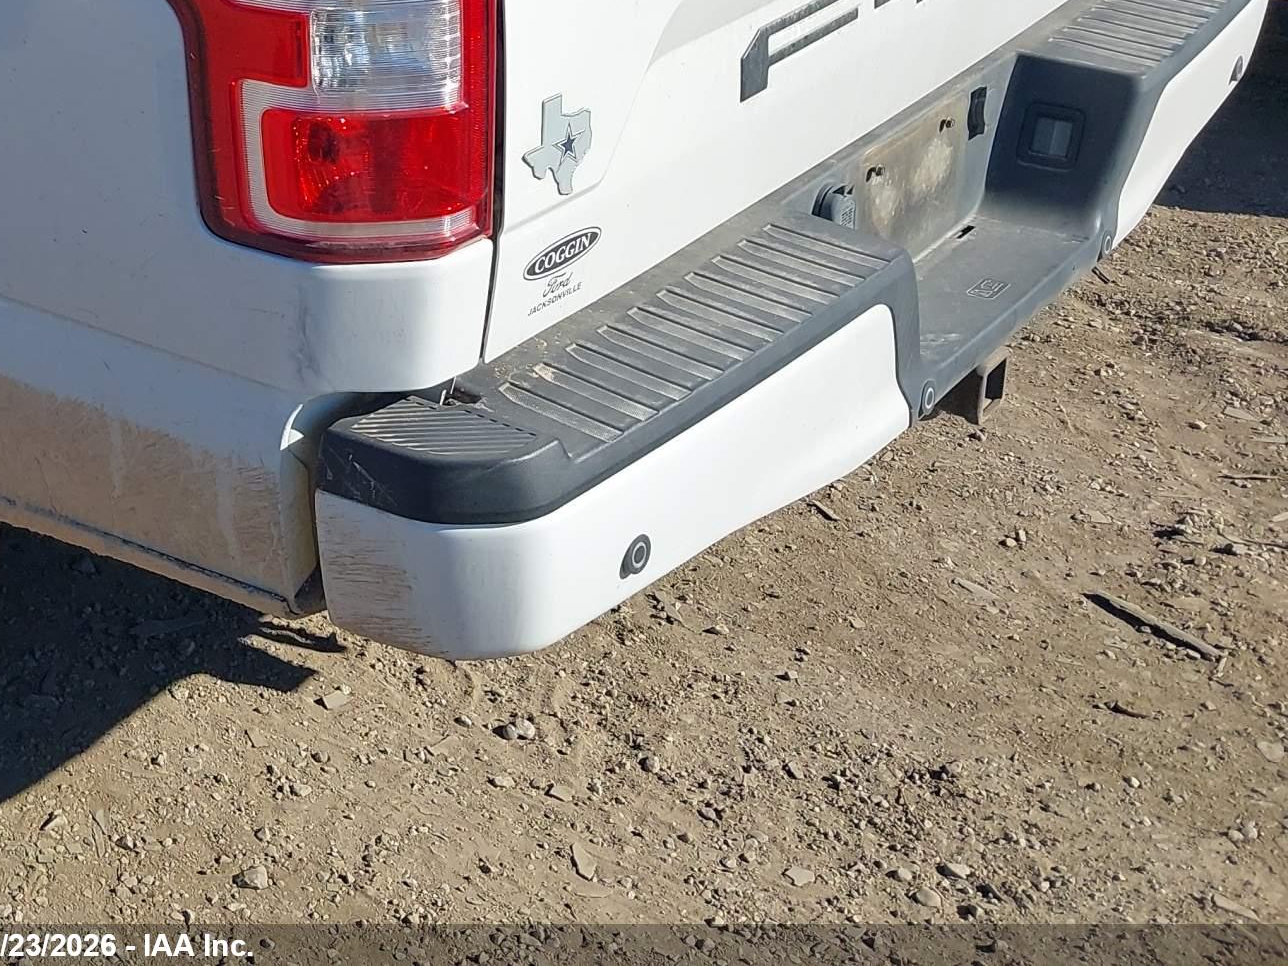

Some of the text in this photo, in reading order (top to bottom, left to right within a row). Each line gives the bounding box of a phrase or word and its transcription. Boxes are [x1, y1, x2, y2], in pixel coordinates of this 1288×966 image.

[534, 232, 592, 274] COGGIN
[527, 281, 583, 317] JACKSONVILLE
[542, 271, 574, 298] Ford
